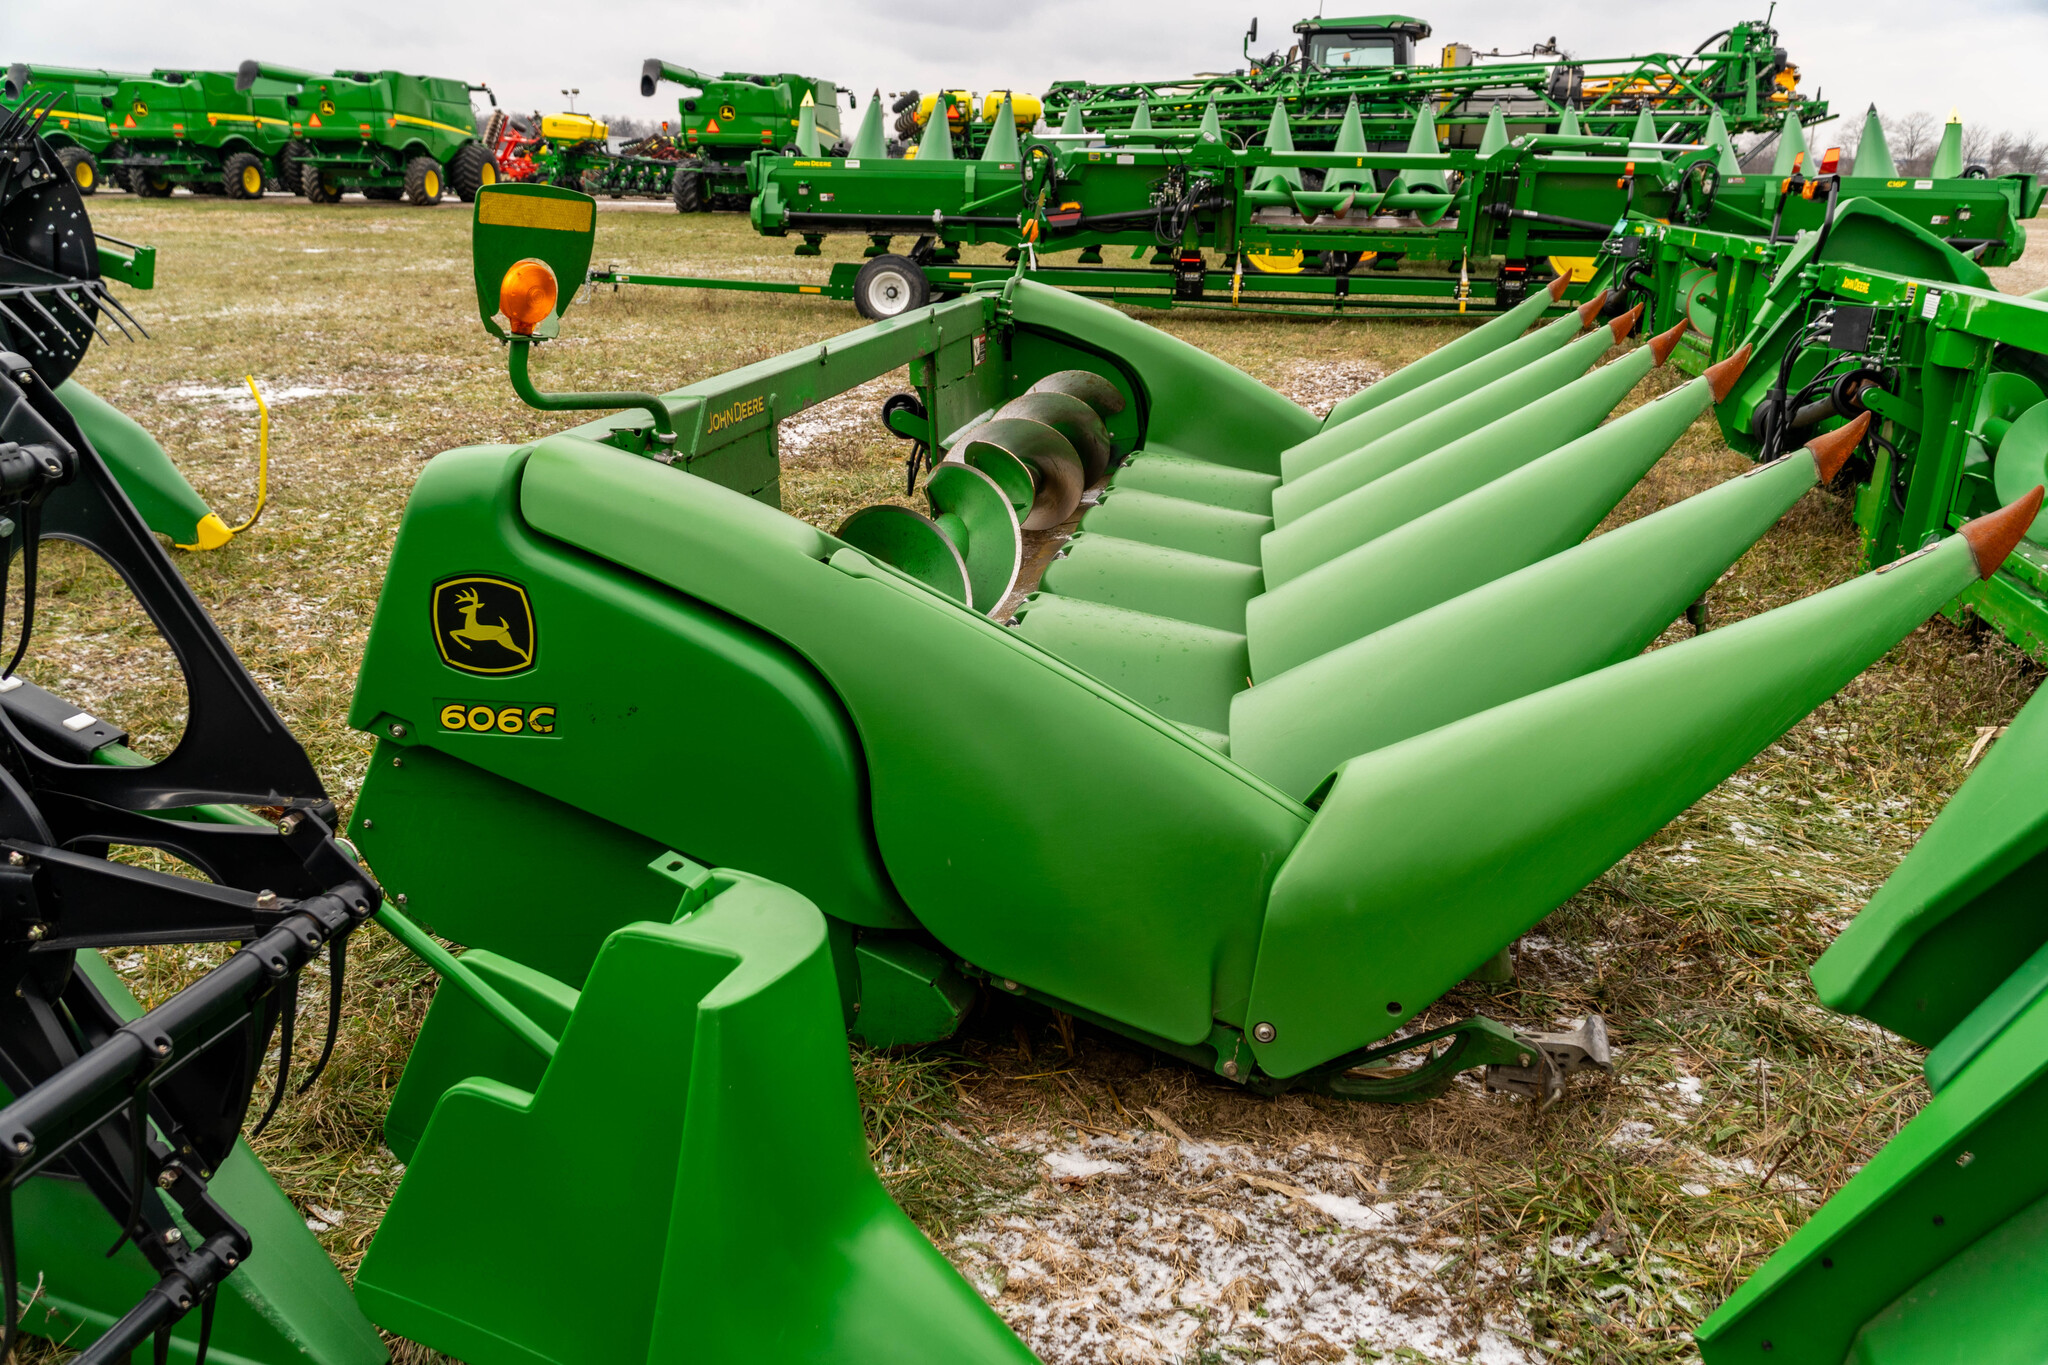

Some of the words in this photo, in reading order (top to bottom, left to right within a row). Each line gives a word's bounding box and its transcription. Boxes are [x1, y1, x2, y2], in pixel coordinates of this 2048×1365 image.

[707, 407, 734, 434] JOHN
[733, 396, 765, 423] DEERE
[440, 704, 557, 735] 606C
